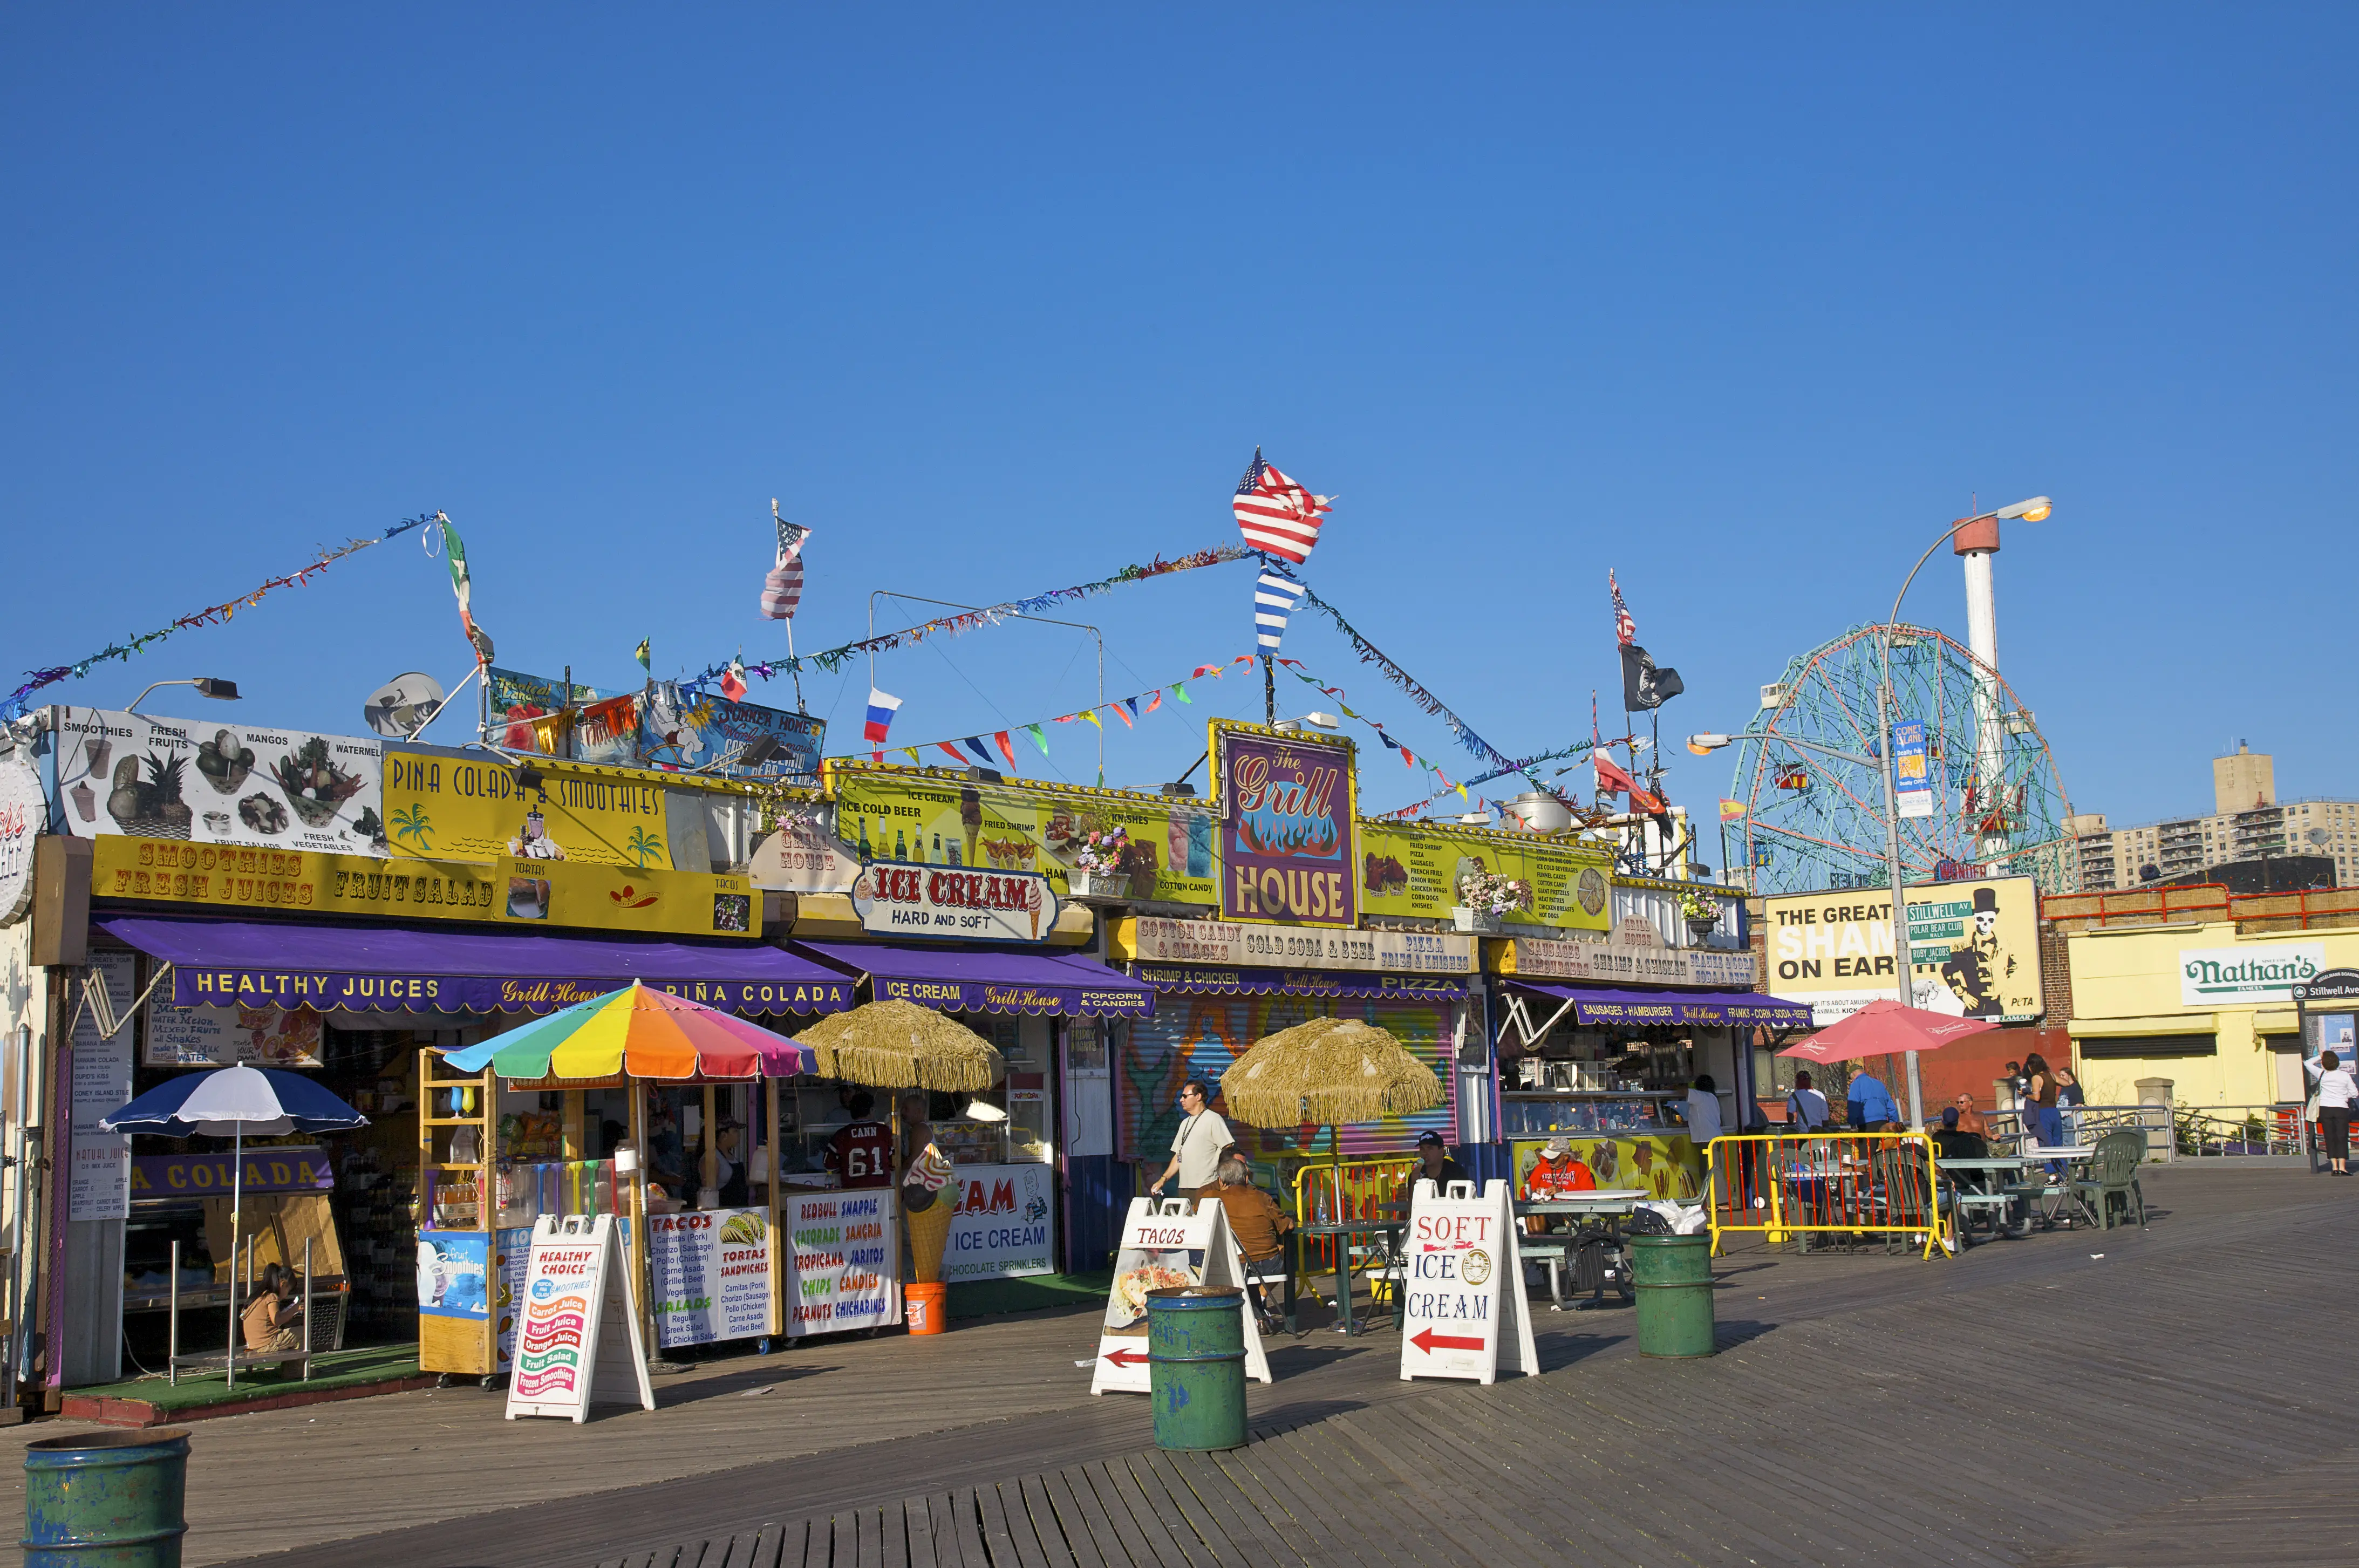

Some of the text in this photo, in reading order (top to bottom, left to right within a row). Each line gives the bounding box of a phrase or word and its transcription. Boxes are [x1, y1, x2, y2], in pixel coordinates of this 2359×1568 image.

[718, 704, 812, 735] SUMMER HOME
[64, 722, 133, 738] SMOOTHIES
[151, 726, 186, 738] FRESH
[1896, 724, 1921, 735] CONEY
[149, 737, 188, 749] FRUITS
[247, 733, 288, 745] MANGOS
[1273, 746, 1301, 769] The
[1234, 755, 1338, 820] Grill
[908, 791, 954, 805] ICE CREAM
[842, 801, 921, 818] ICE COLD BEER
[984, 820, 1035, 832] FRIED SHRIMP
[292, 841, 353, 851] VEGETABLES
[303, 833, 334, 842] FRESH
[781, 831, 831, 851] GRILL
[139, 842, 302, 877] SMOOTHIES
[780, 851, 835, 871] HOUSE
[515, 862, 545, 876] TORTAS
[114, 869, 313, 905] FRESH JUICES
[335, 869, 495, 908] FRUIT SALAD
[715, 878, 738, 891] TACOS
[873, 865, 1030, 912] ICE CREAM
[1160, 881, 1212, 894] COTTON CANDY
[1235, 865, 1345, 918] HOUSE
[892, 910, 991, 929] HARD AND SOFT
[1910, 904, 1956, 921] STILLWELL
[1140, 920, 1243, 942] COTTON CANDY
[1625, 918, 1651, 932] GRILL
[1910, 922, 1962, 934] POLAR BEAR CLUB
[1406, 935, 1444, 953] PIZZA
[1625, 932, 1652, 946] HOUSE
[1528, 940, 1580, 959] SAUSAGES
[1913, 947, 1949, 958] RUBY JACOBS
[1519, 957, 1590, 977] HAMBURGERS
[197, 973, 438, 998] HEALTHY JUICES
[177, 1053, 208, 1062] WATER
[851, 1127, 877, 1138] CANN
[848, 1147, 883, 1177] 61
[167, 1161, 319, 1188] COLADA
[801, 1198, 877, 1222] REDBULL SNAPPLE
[652, 1215, 713, 1232] TACOS
[1416, 1216, 1492, 1241] SOFT
[657, 1233, 708, 1244] Carnitas (Pork)
[795, 1222, 883, 1248] GATORADE SANGRIA
[956, 1226, 1045, 1251] ICE CREAM
[1137, 1228, 1185, 1244] TACOS
[431, 1252, 485, 1276] Smoothies
[539, 1251, 592, 1263] HEALTHY
[657, 1253, 708, 1265] Pollo (Chicken)
[723, 1248, 766, 1263] TORTAS
[794, 1247, 884, 1272] TROPICANA JARITOS
[542, 1264, 586, 1275] CHOICE
[684, 1265, 705, 1273] Asada
[720, 1262, 768, 1278] SANDWICHES
[1414, 1255, 1456, 1279] ICE
[661, 1275, 706, 1287] (Grilled Beef)
[725, 1281, 765, 1292] Carnitas (Pork)
[802, 1273, 878, 1298] CHIPS CANDIES
[666, 1287, 703, 1297] Vegetarian
[721, 1291, 770, 1303] Chorizo (Sausage)
[531, 1299, 583, 1316] Carrot Juice
[656, 1296, 713, 1314] SALADS
[725, 1301, 767, 1313] Pollo (Chicken)
[792, 1303, 833, 1324] PEANUTS
[836, 1297, 886, 1319] CHICHARINES
[1408, 1293, 1488, 1320] CREAM
[531, 1317, 577, 1334] Fruit Juice
[672, 1314, 697, 1324] Regular
[665, 1323, 703, 1334] Greek Salad
[729, 1322, 765, 1334] (Grilled Beef)
[526, 1333, 577, 1351] Orange Juice
[526, 1352, 572, 1369] Fruit Salad
[520, 1368, 572, 1388] Frozen Smoothies
